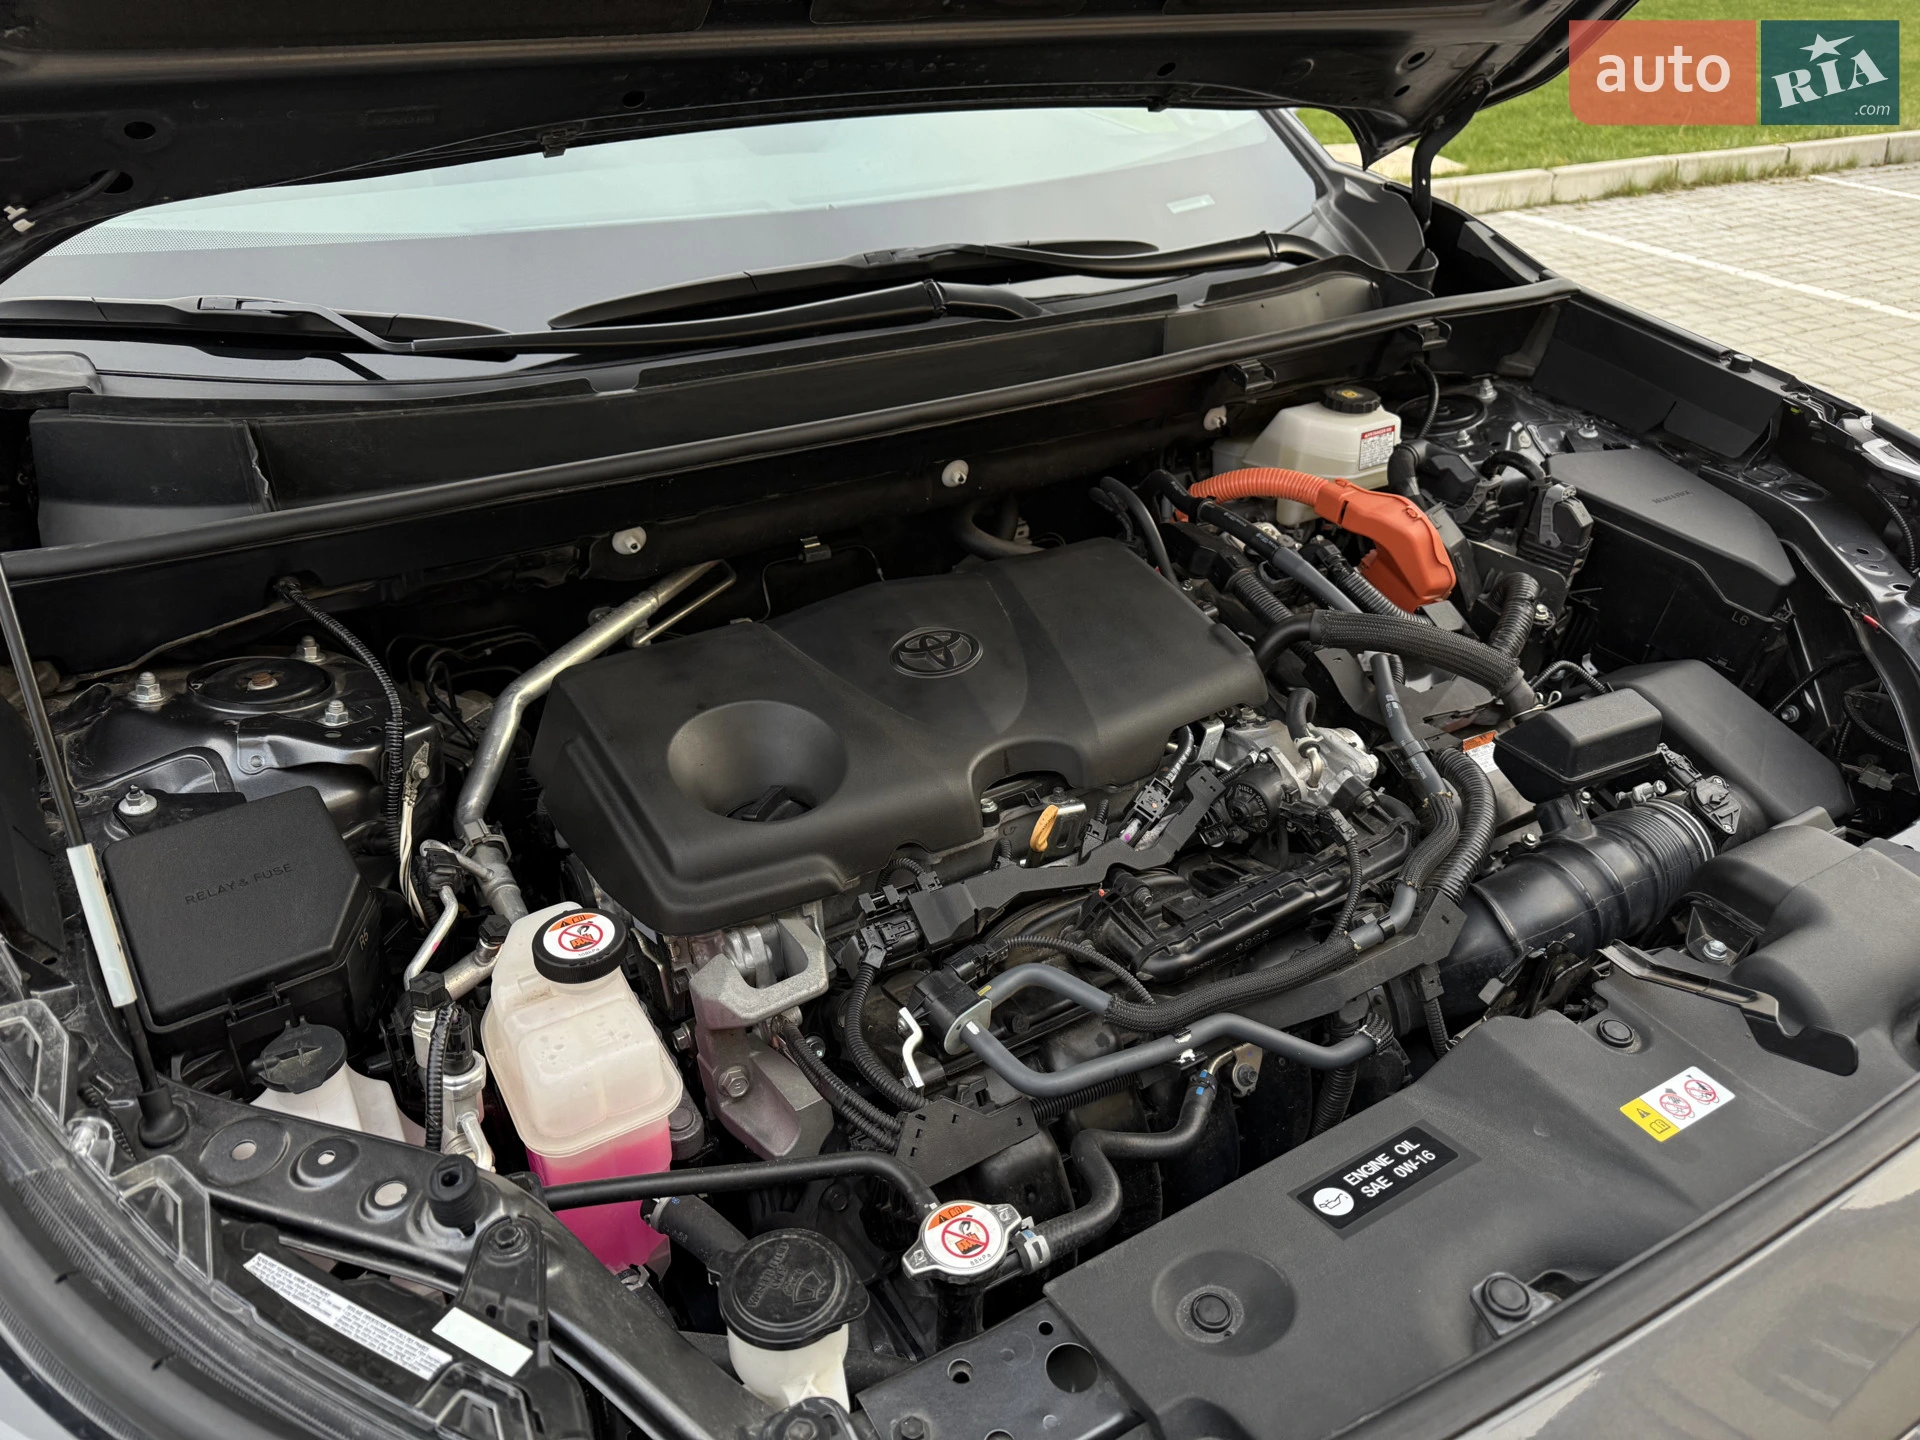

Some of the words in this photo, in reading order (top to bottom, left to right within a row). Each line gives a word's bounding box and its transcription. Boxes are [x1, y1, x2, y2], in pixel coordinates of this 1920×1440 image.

[184, 880, 235, 905] RELAY
[253, 863, 293, 882] FUSE
[1342, 1152, 1395, 1186] ENGINE
[1393, 1139, 1421, 1156] OIL
[1360, 1175, 1394, 1198] SAE
[1392, 1149, 1436, 1178] 0W-16
